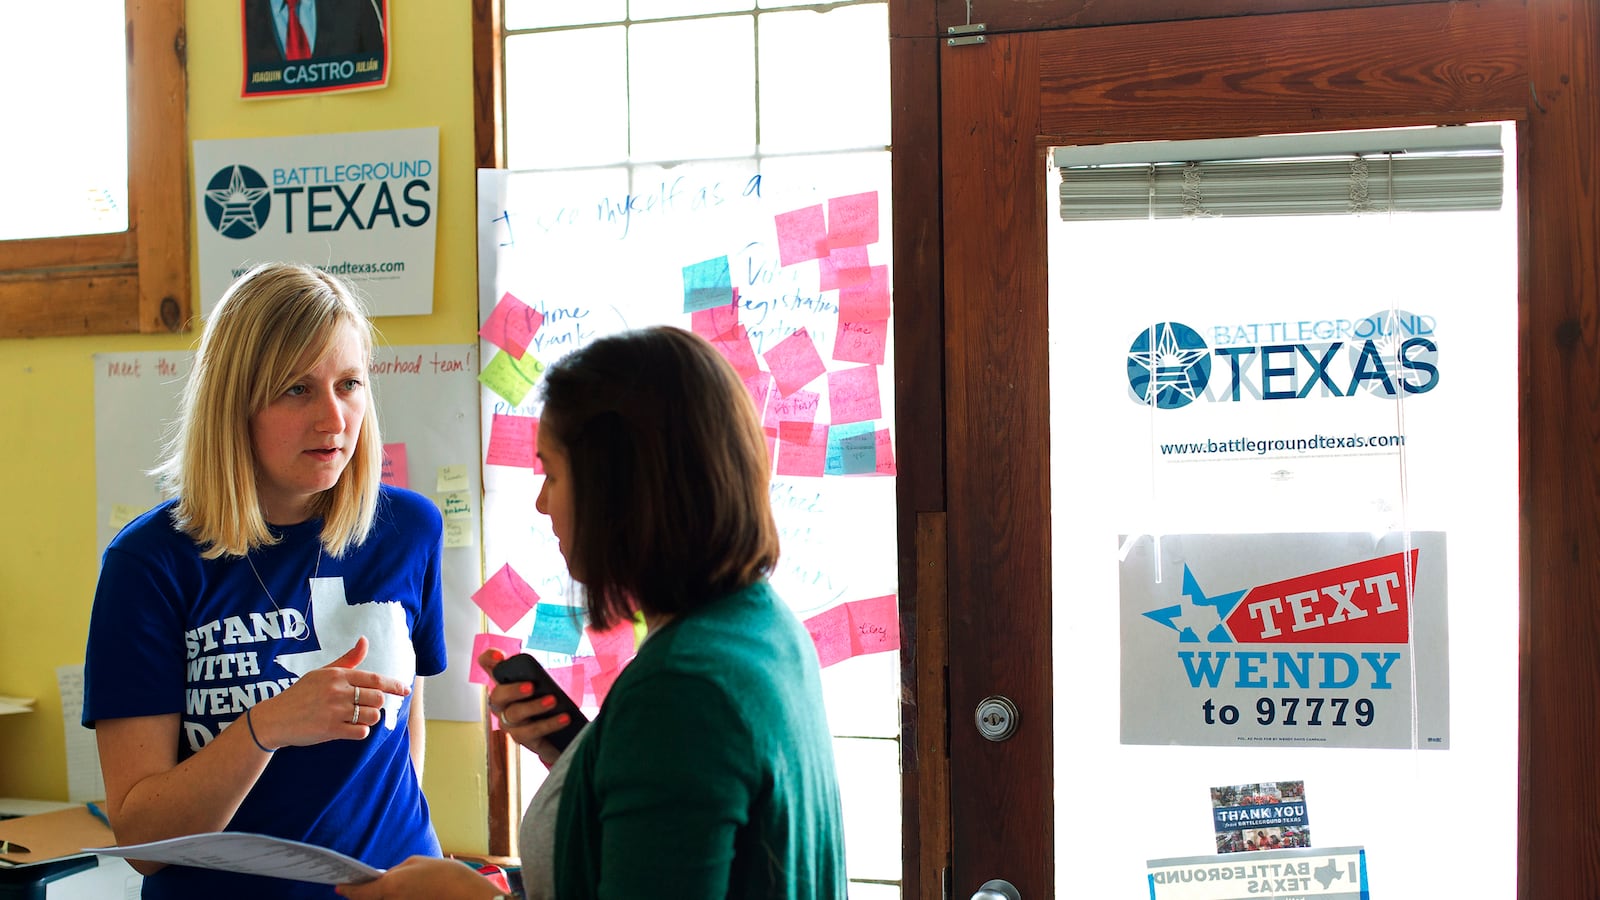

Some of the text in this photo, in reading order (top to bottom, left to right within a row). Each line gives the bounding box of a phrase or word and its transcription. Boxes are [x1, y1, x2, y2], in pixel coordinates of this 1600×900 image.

[283, 60, 354, 83] CASTRO
[273, 160, 432, 185] BATTLEGROUND
[273, 180, 431, 234] TEXAS
[597, 176, 685, 240] myself
[742, 174, 763, 198] a
[525, 300, 590, 332] Phone
[1214, 315, 1437, 345] BATTLEGROUND
[369, 354, 422, 375] borhood
[1215, 337, 1439, 402] TEXAS
[1160, 433, 1406, 455] www.battlegroundtexas.com
[1248, 571, 1401, 639] TEXT
[185, 608, 305, 659] STAND
[187, 652, 260, 682] WITH
[1178, 651, 1400, 690] WENDY
[1202, 697, 1375, 727] to 97779
[1219, 805, 1304, 821] THANK YOU
[1238, 819, 1282, 827] BATTLEGROUND
